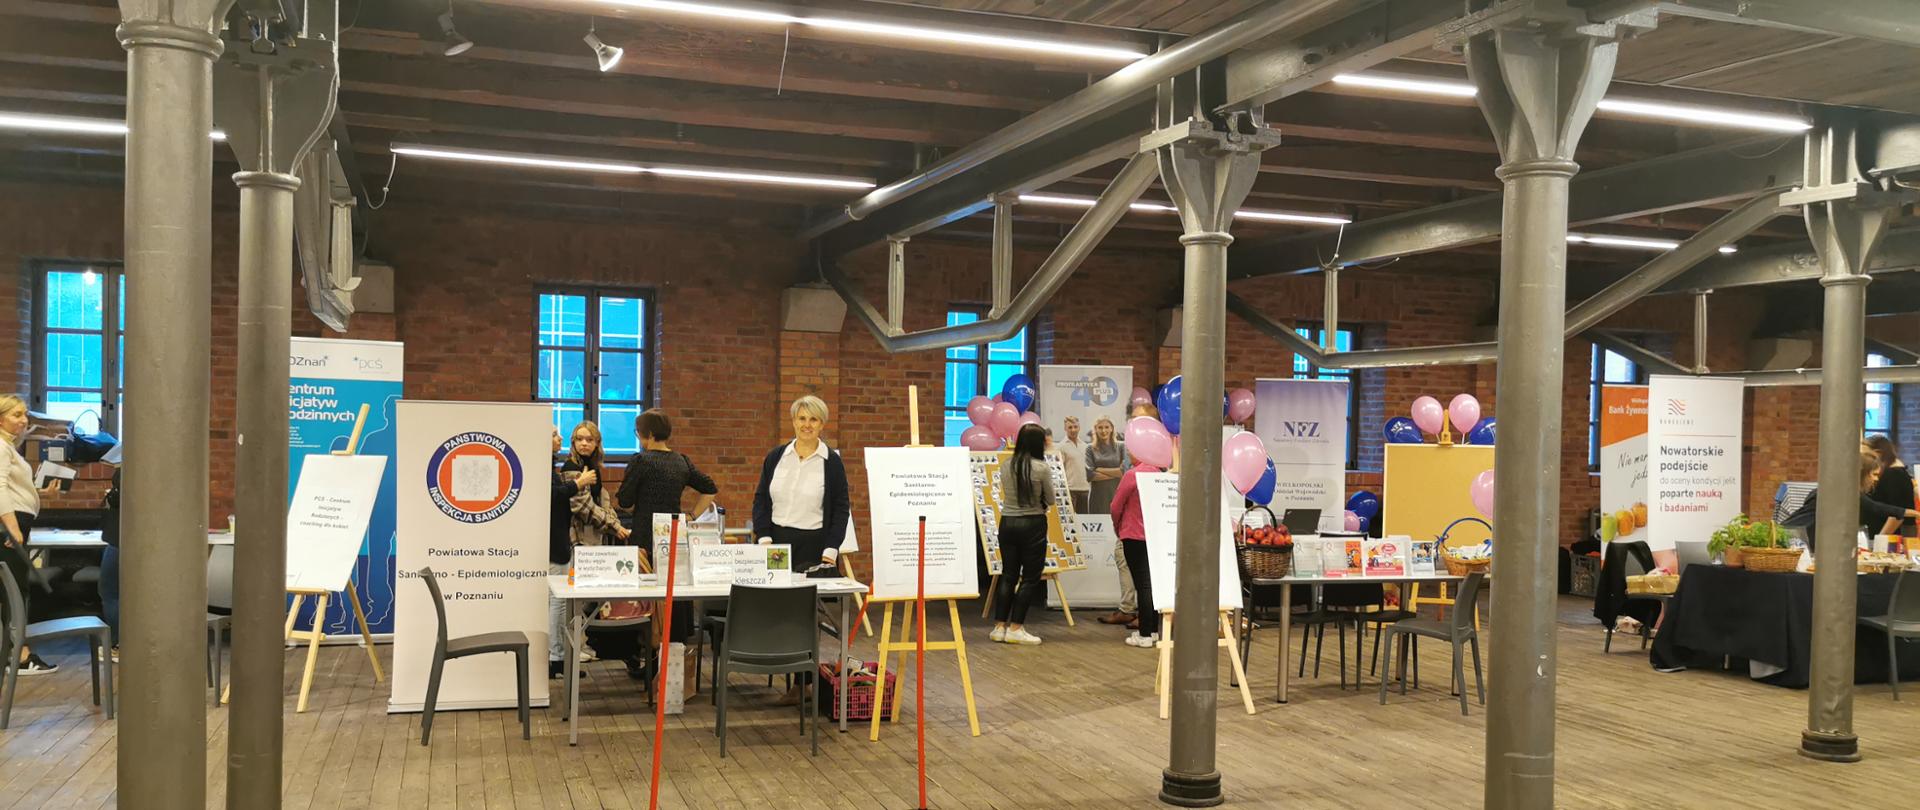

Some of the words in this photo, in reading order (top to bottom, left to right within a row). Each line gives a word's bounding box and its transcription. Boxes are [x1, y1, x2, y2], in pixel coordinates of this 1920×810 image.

[289, 383, 335, 395] entrum
[289, 395, 338, 410] icjatyw
[1609, 405, 1624, 414] Bank
[289, 409, 355, 423] odzinnych
[1283, 421, 1321, 438] NFZ
[443, 431, 507, 452] PAŃSTWOWA
[1660, 444, 1724, 456] Nowatorskie
[1660, 459, 1708, 472] podejście
[1660, 477, 1669, 485] do
[1671, 478, 1690, 487] oceny
[1692, 477, 1722, 487] kondycji
[1723, 477, 1736, 487] jelit
[1660, 490, 1694, 500] poparte
[1695, 489, 1722, 500] nauką
[430, 486, 473, 522] INSPEKCJA
[474, 487, 519, 522] SANITARNA
[1664, 502, 1708, 512] badaniami
[1081, 522, 1103, 533] NFZ
[428, 547, 485, 557] Powiatowa
[487, 547, 519, 558] Stacja
[398, 570, 448, 579] Sanno
[457, 569, 548, 579] Epidemiologiczna
[735, 577, 766, 585] kleszcza
[455, 592, 504, 600] Poznaniu
